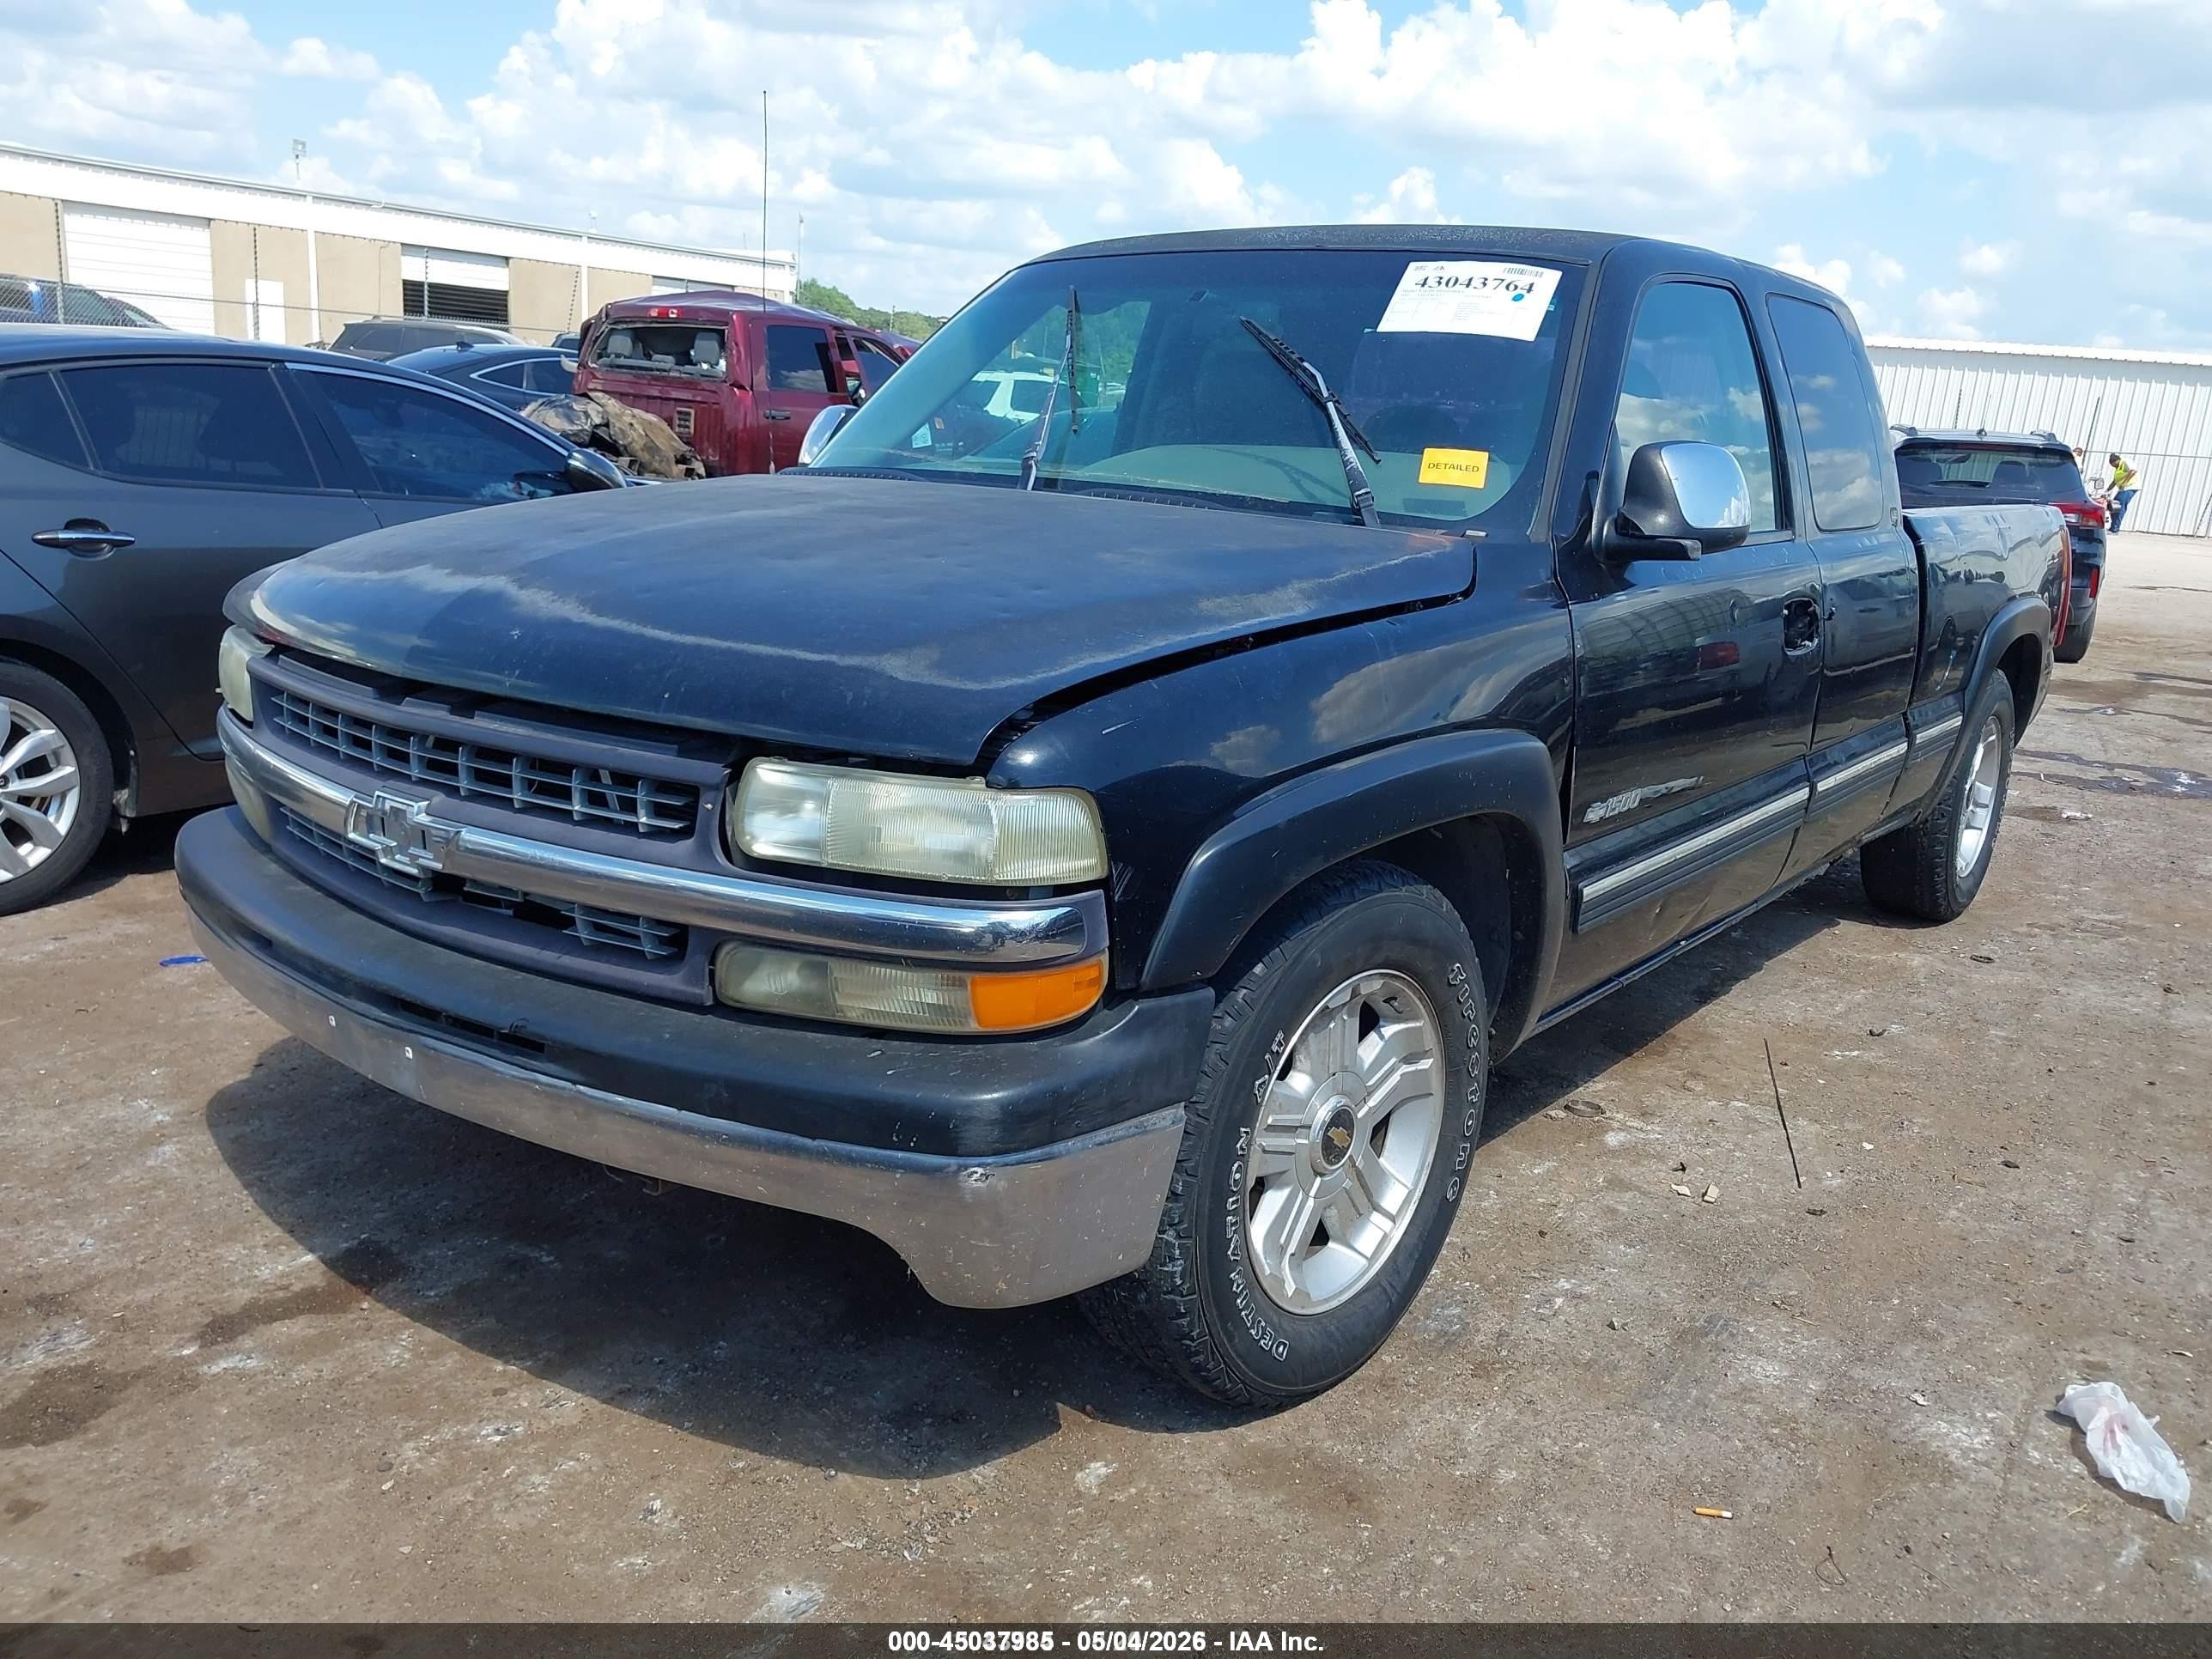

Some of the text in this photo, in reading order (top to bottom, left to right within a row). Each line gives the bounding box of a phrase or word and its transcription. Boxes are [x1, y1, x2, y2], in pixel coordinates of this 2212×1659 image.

[1414, 275, 1535, 295] 43043764
[1427, 462, 1480, 472] DETAILED
[1225, 1127, 1290, 1362] DESTINATION
